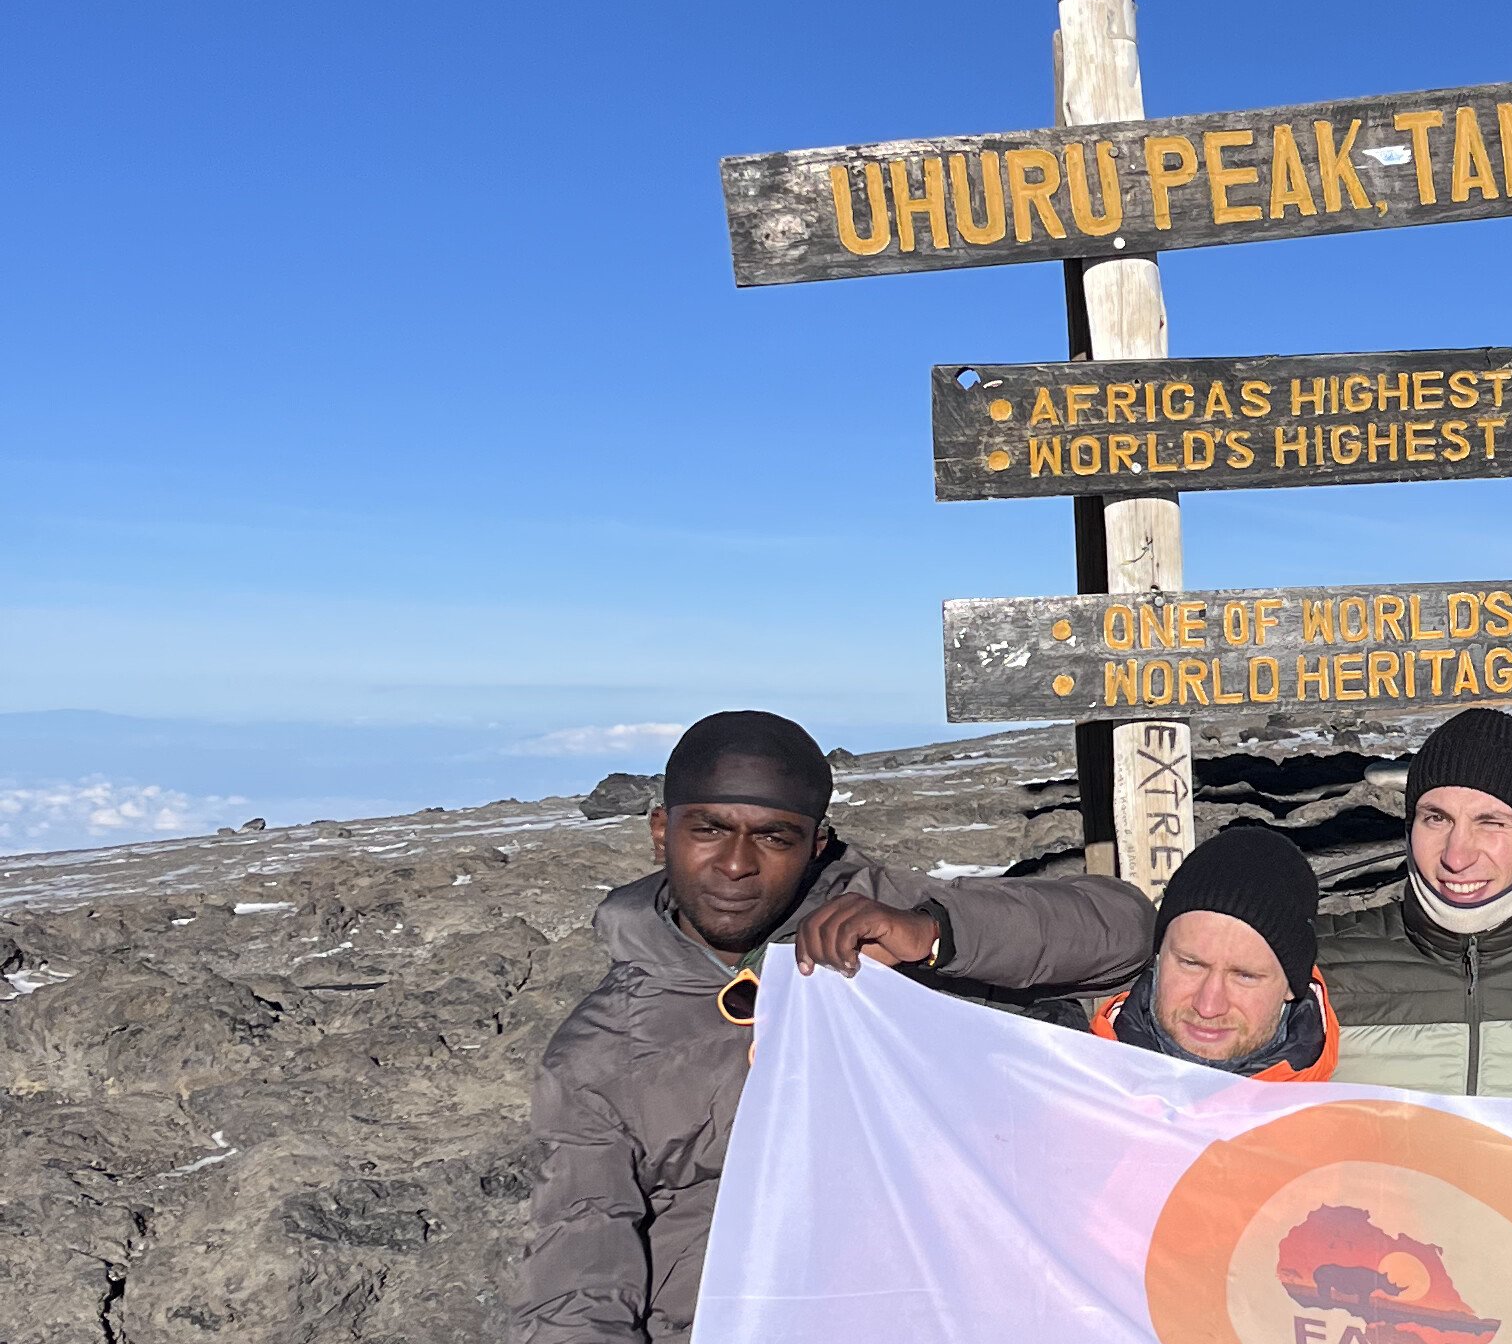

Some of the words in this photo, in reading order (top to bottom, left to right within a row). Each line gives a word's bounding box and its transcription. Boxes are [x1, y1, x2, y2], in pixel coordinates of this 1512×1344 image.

[831, 141, 1124, 256] UHURU
[1029, 427, 1256, 479] WORLD'S
[1275, 417, 1507, 468] HIGHEST
[1104, 599, 1206, 651] ONE
[1224, 598, 1284, 647] OF
[1104, 656, 1280, 707] WORLD
